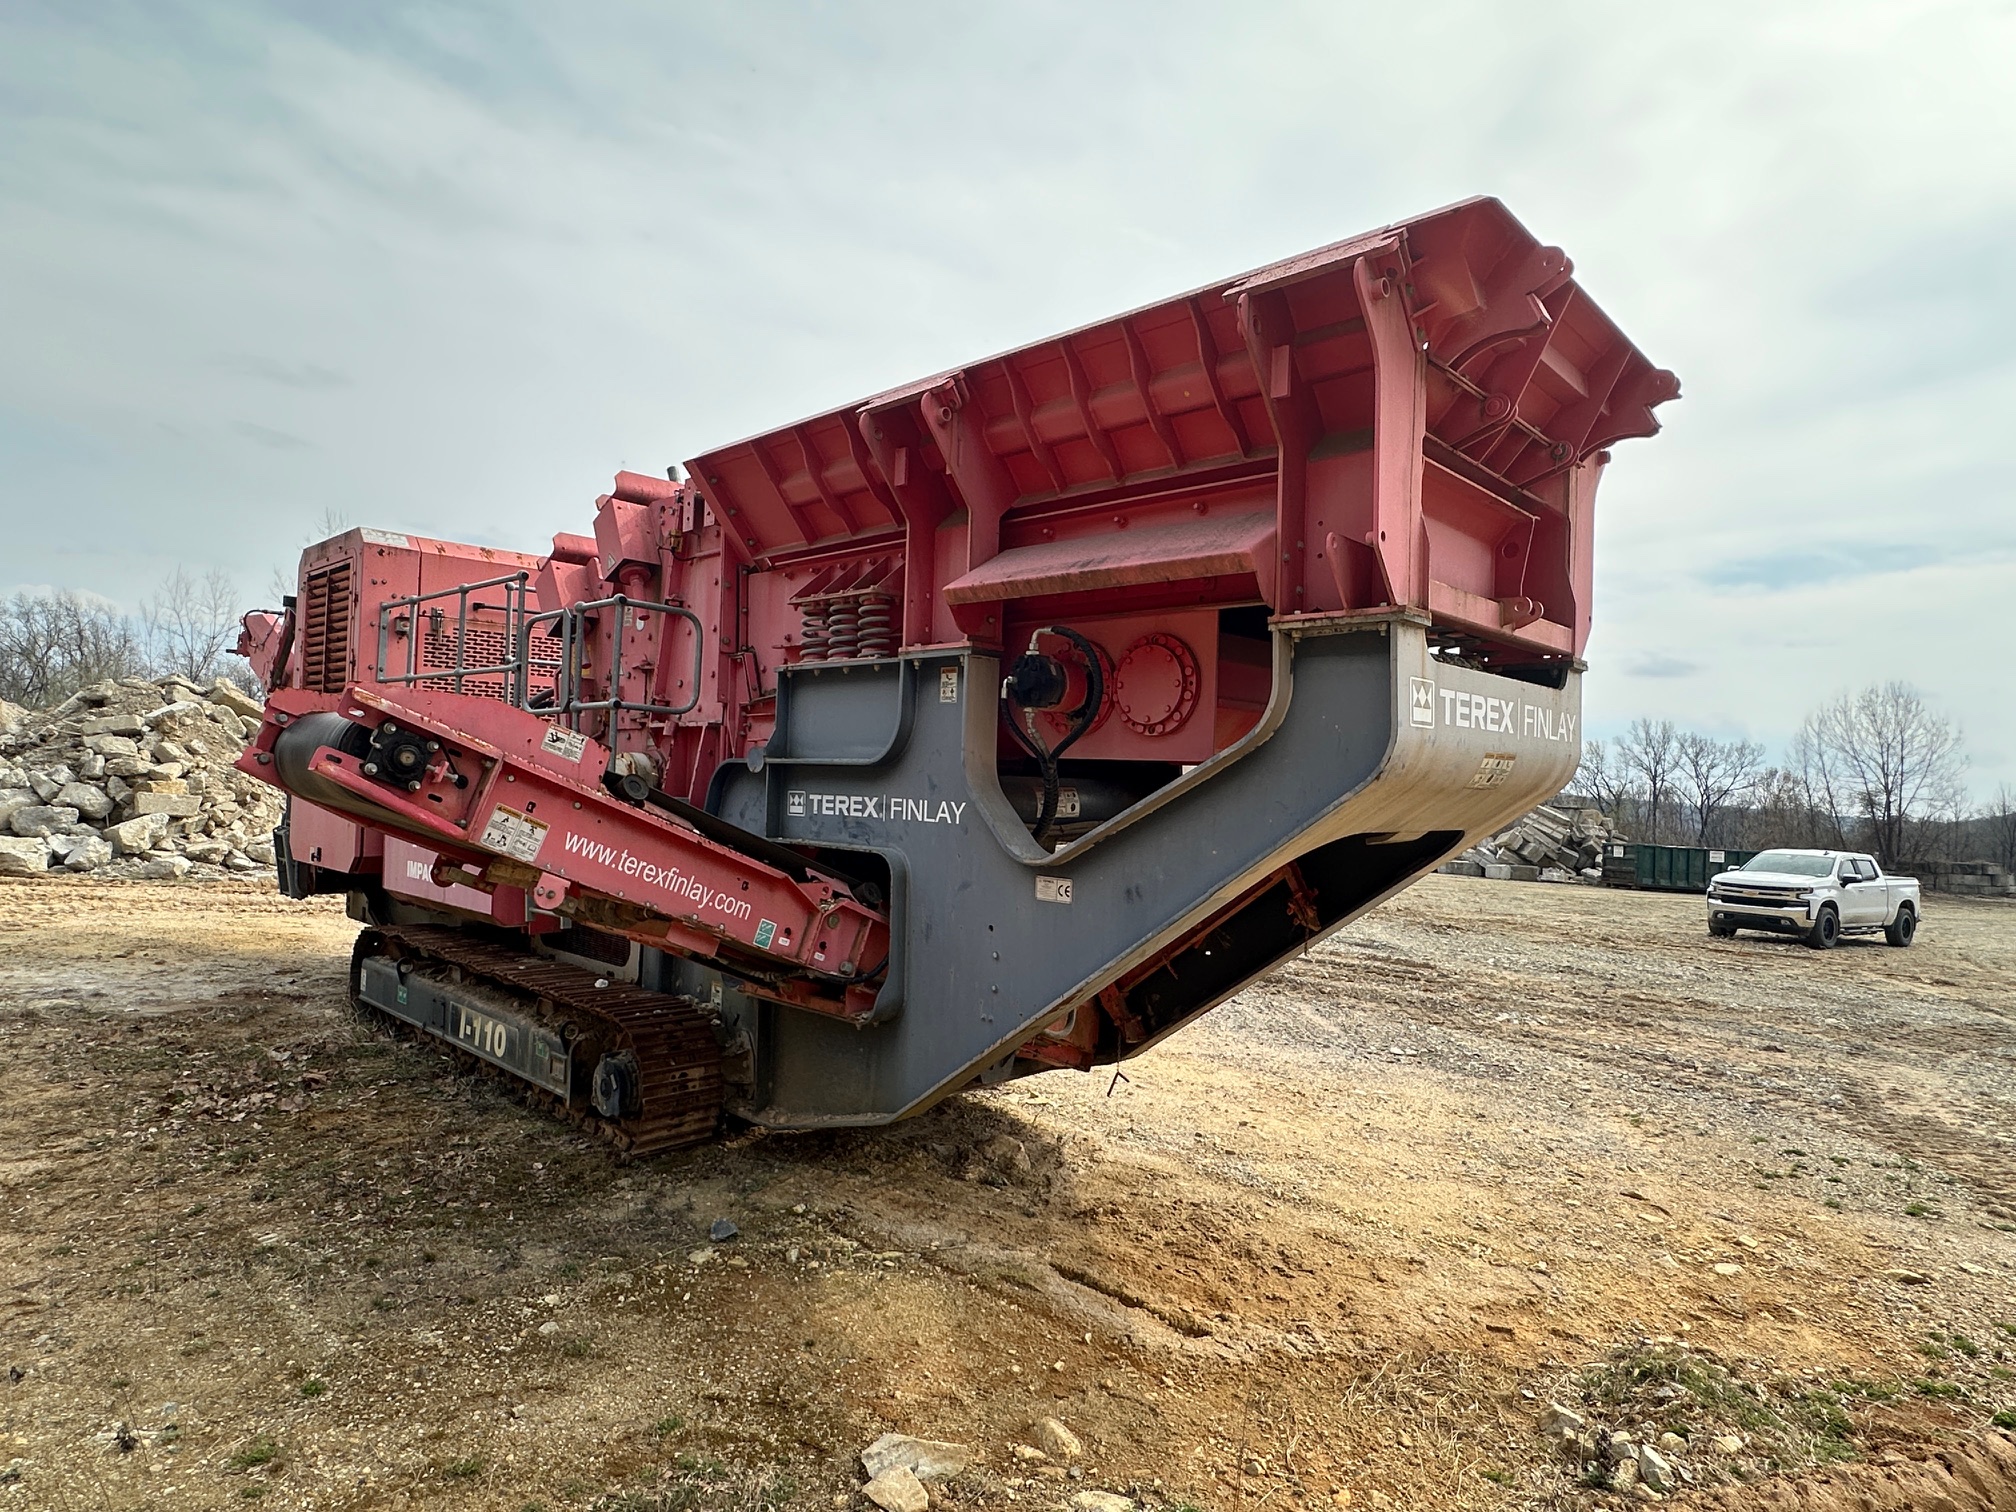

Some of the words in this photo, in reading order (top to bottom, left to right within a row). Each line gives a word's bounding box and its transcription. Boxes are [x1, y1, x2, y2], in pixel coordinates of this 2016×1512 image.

[1439, 687, 1514, 734] TEREX
[1523, 704, 1576, 743] FINLAY
[809, 794, 879, 818] TEREX
[890, 797, 966, 824] FINLAY
[565, 831, 752, 920] www.terexfinlay.com
[458, 1006, 507, 1058] I-110
